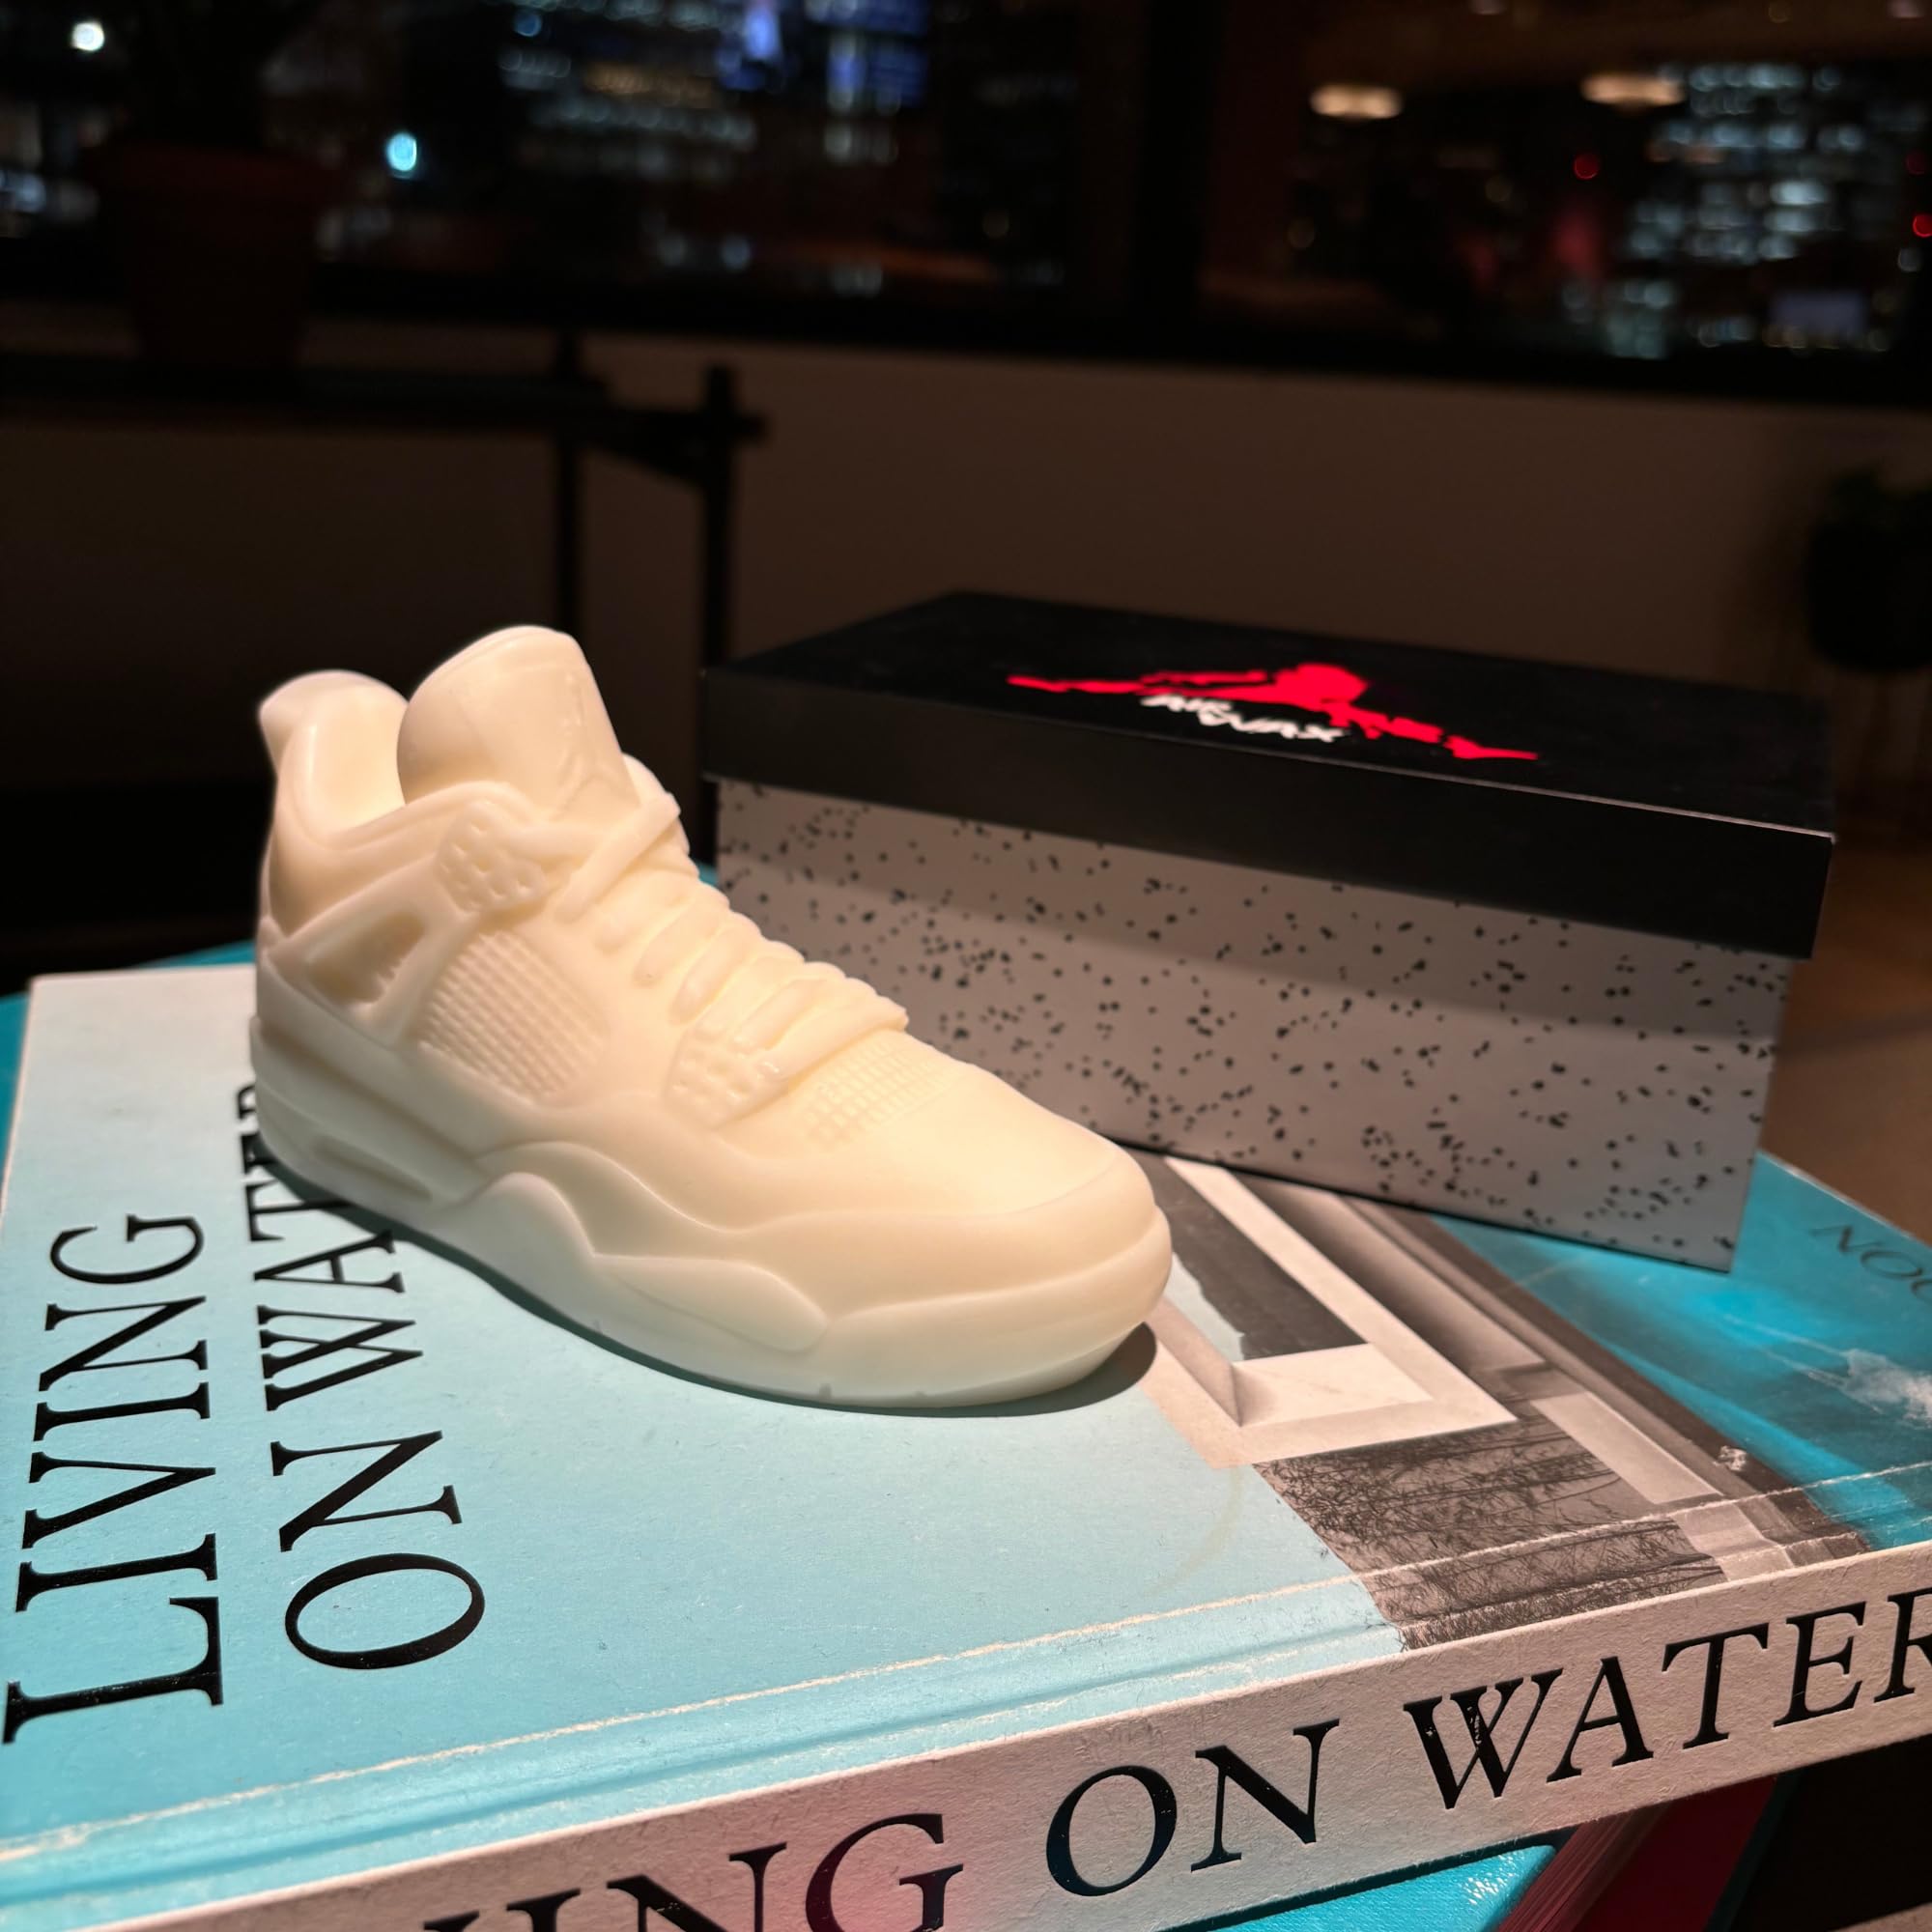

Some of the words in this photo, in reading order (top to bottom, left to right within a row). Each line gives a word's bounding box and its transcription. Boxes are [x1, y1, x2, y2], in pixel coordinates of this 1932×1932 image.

[236, 1083, 423, 1411] WAT
[2, 1214, 223, 1745] LIVING
[270, 1430, 485, 1669] ON
[1045, 1719, 1340, 1897] ON
